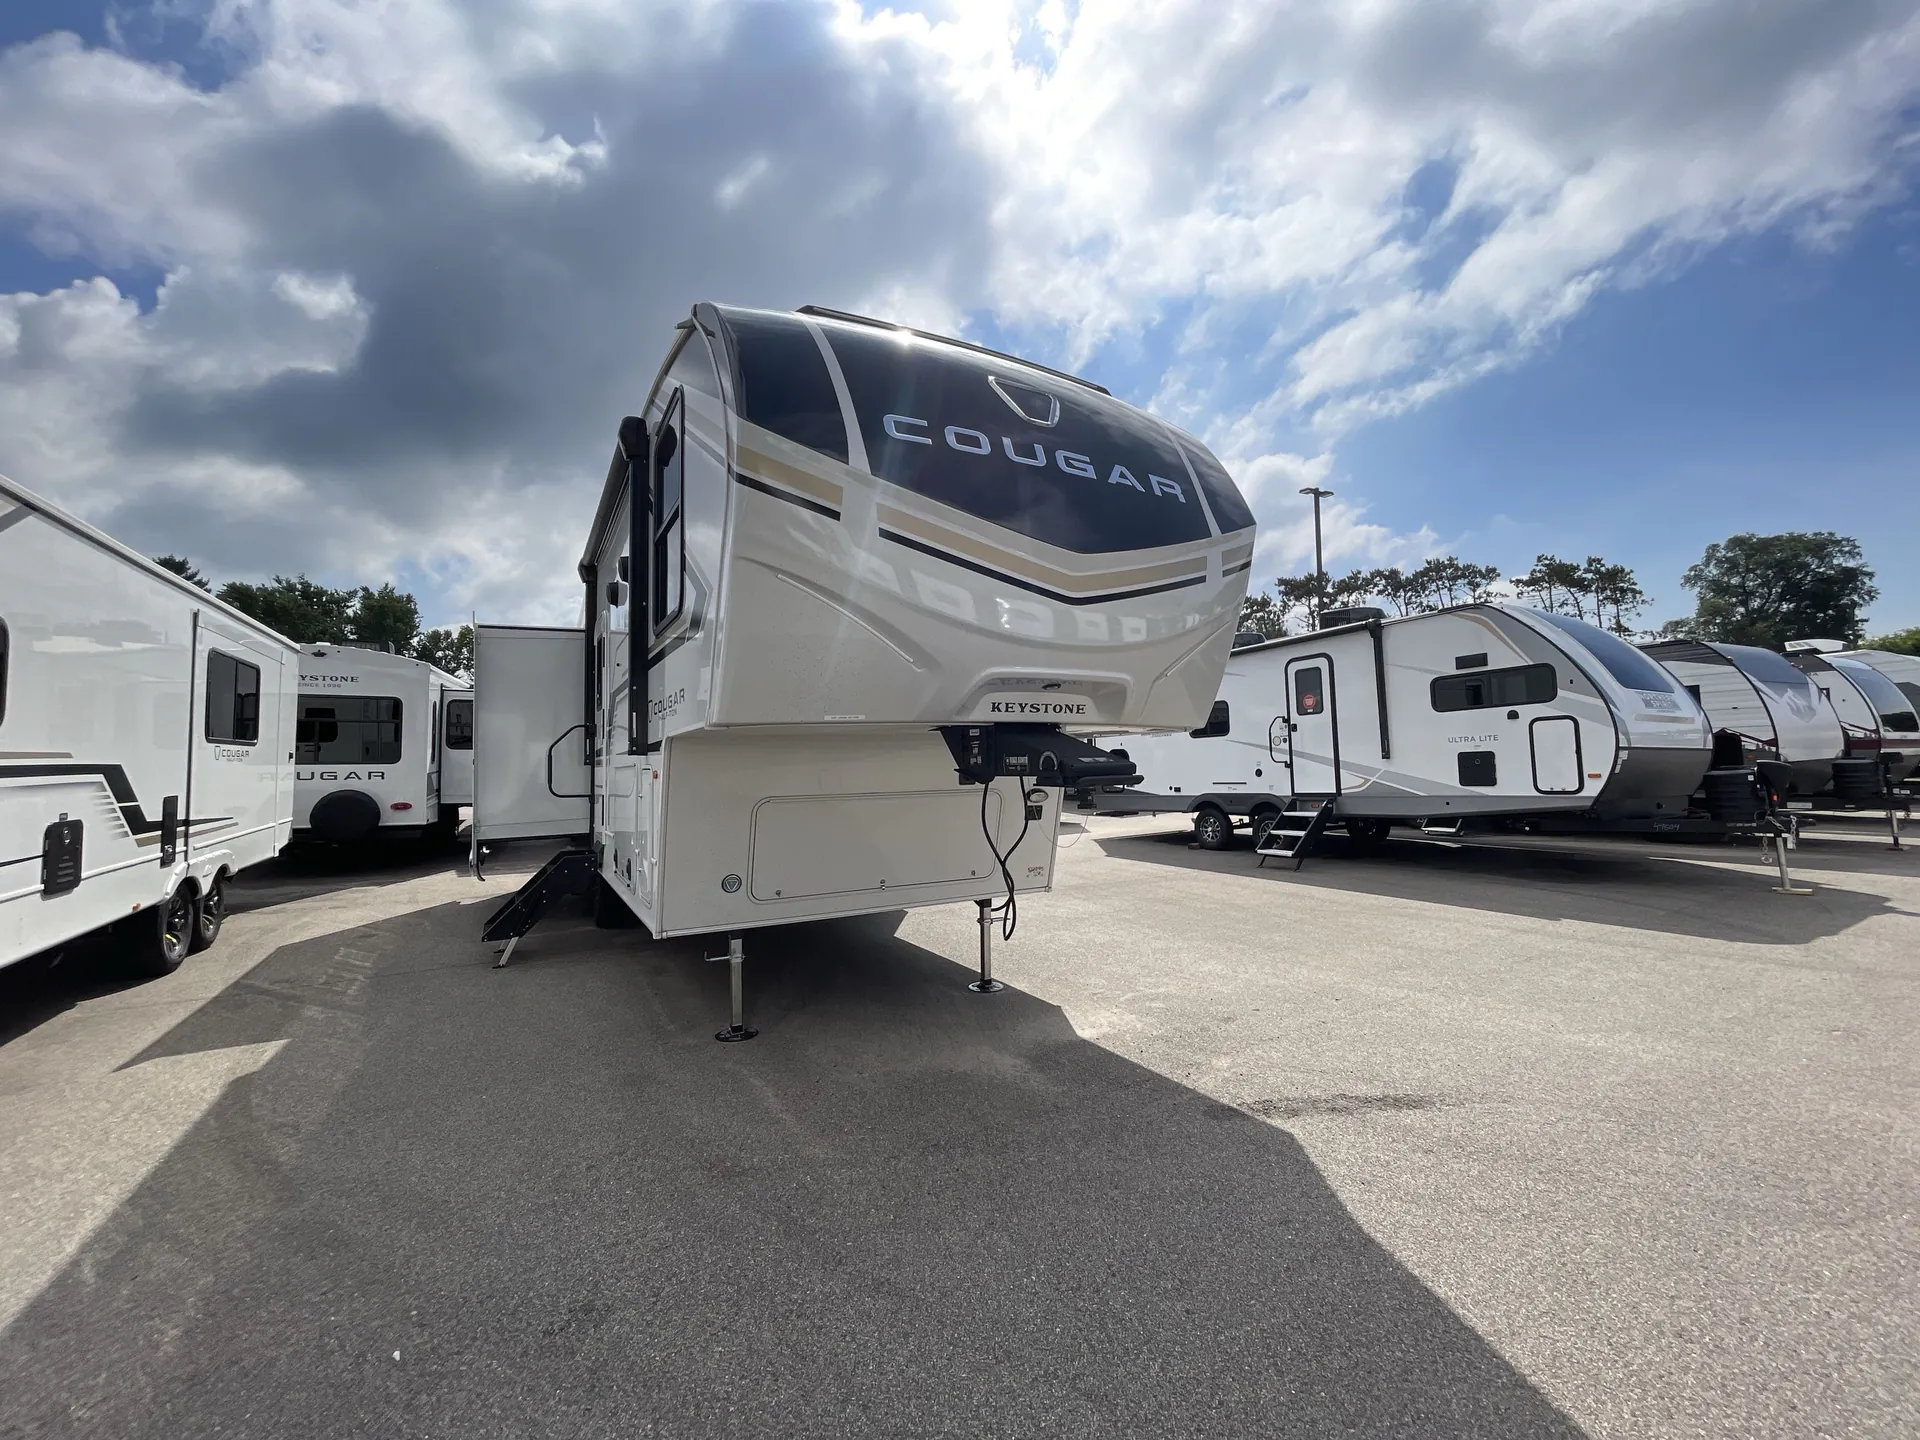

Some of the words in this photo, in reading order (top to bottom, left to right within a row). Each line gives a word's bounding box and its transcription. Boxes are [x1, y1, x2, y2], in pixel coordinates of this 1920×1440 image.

[883, 413, 1187, 504] COUGAR
[298, 674, 360, 683] YSTONE
[653, 688, 685, 715] COUGAR
[990, 701, 1087, 715] KEYSTONE
[1447, 735, 1477, 744] ULTRA
[1479, 734, 1500, 742] LITE
[221, 749, 250, 758] COUGAR
[296, 771, 386, 781] UGAR
